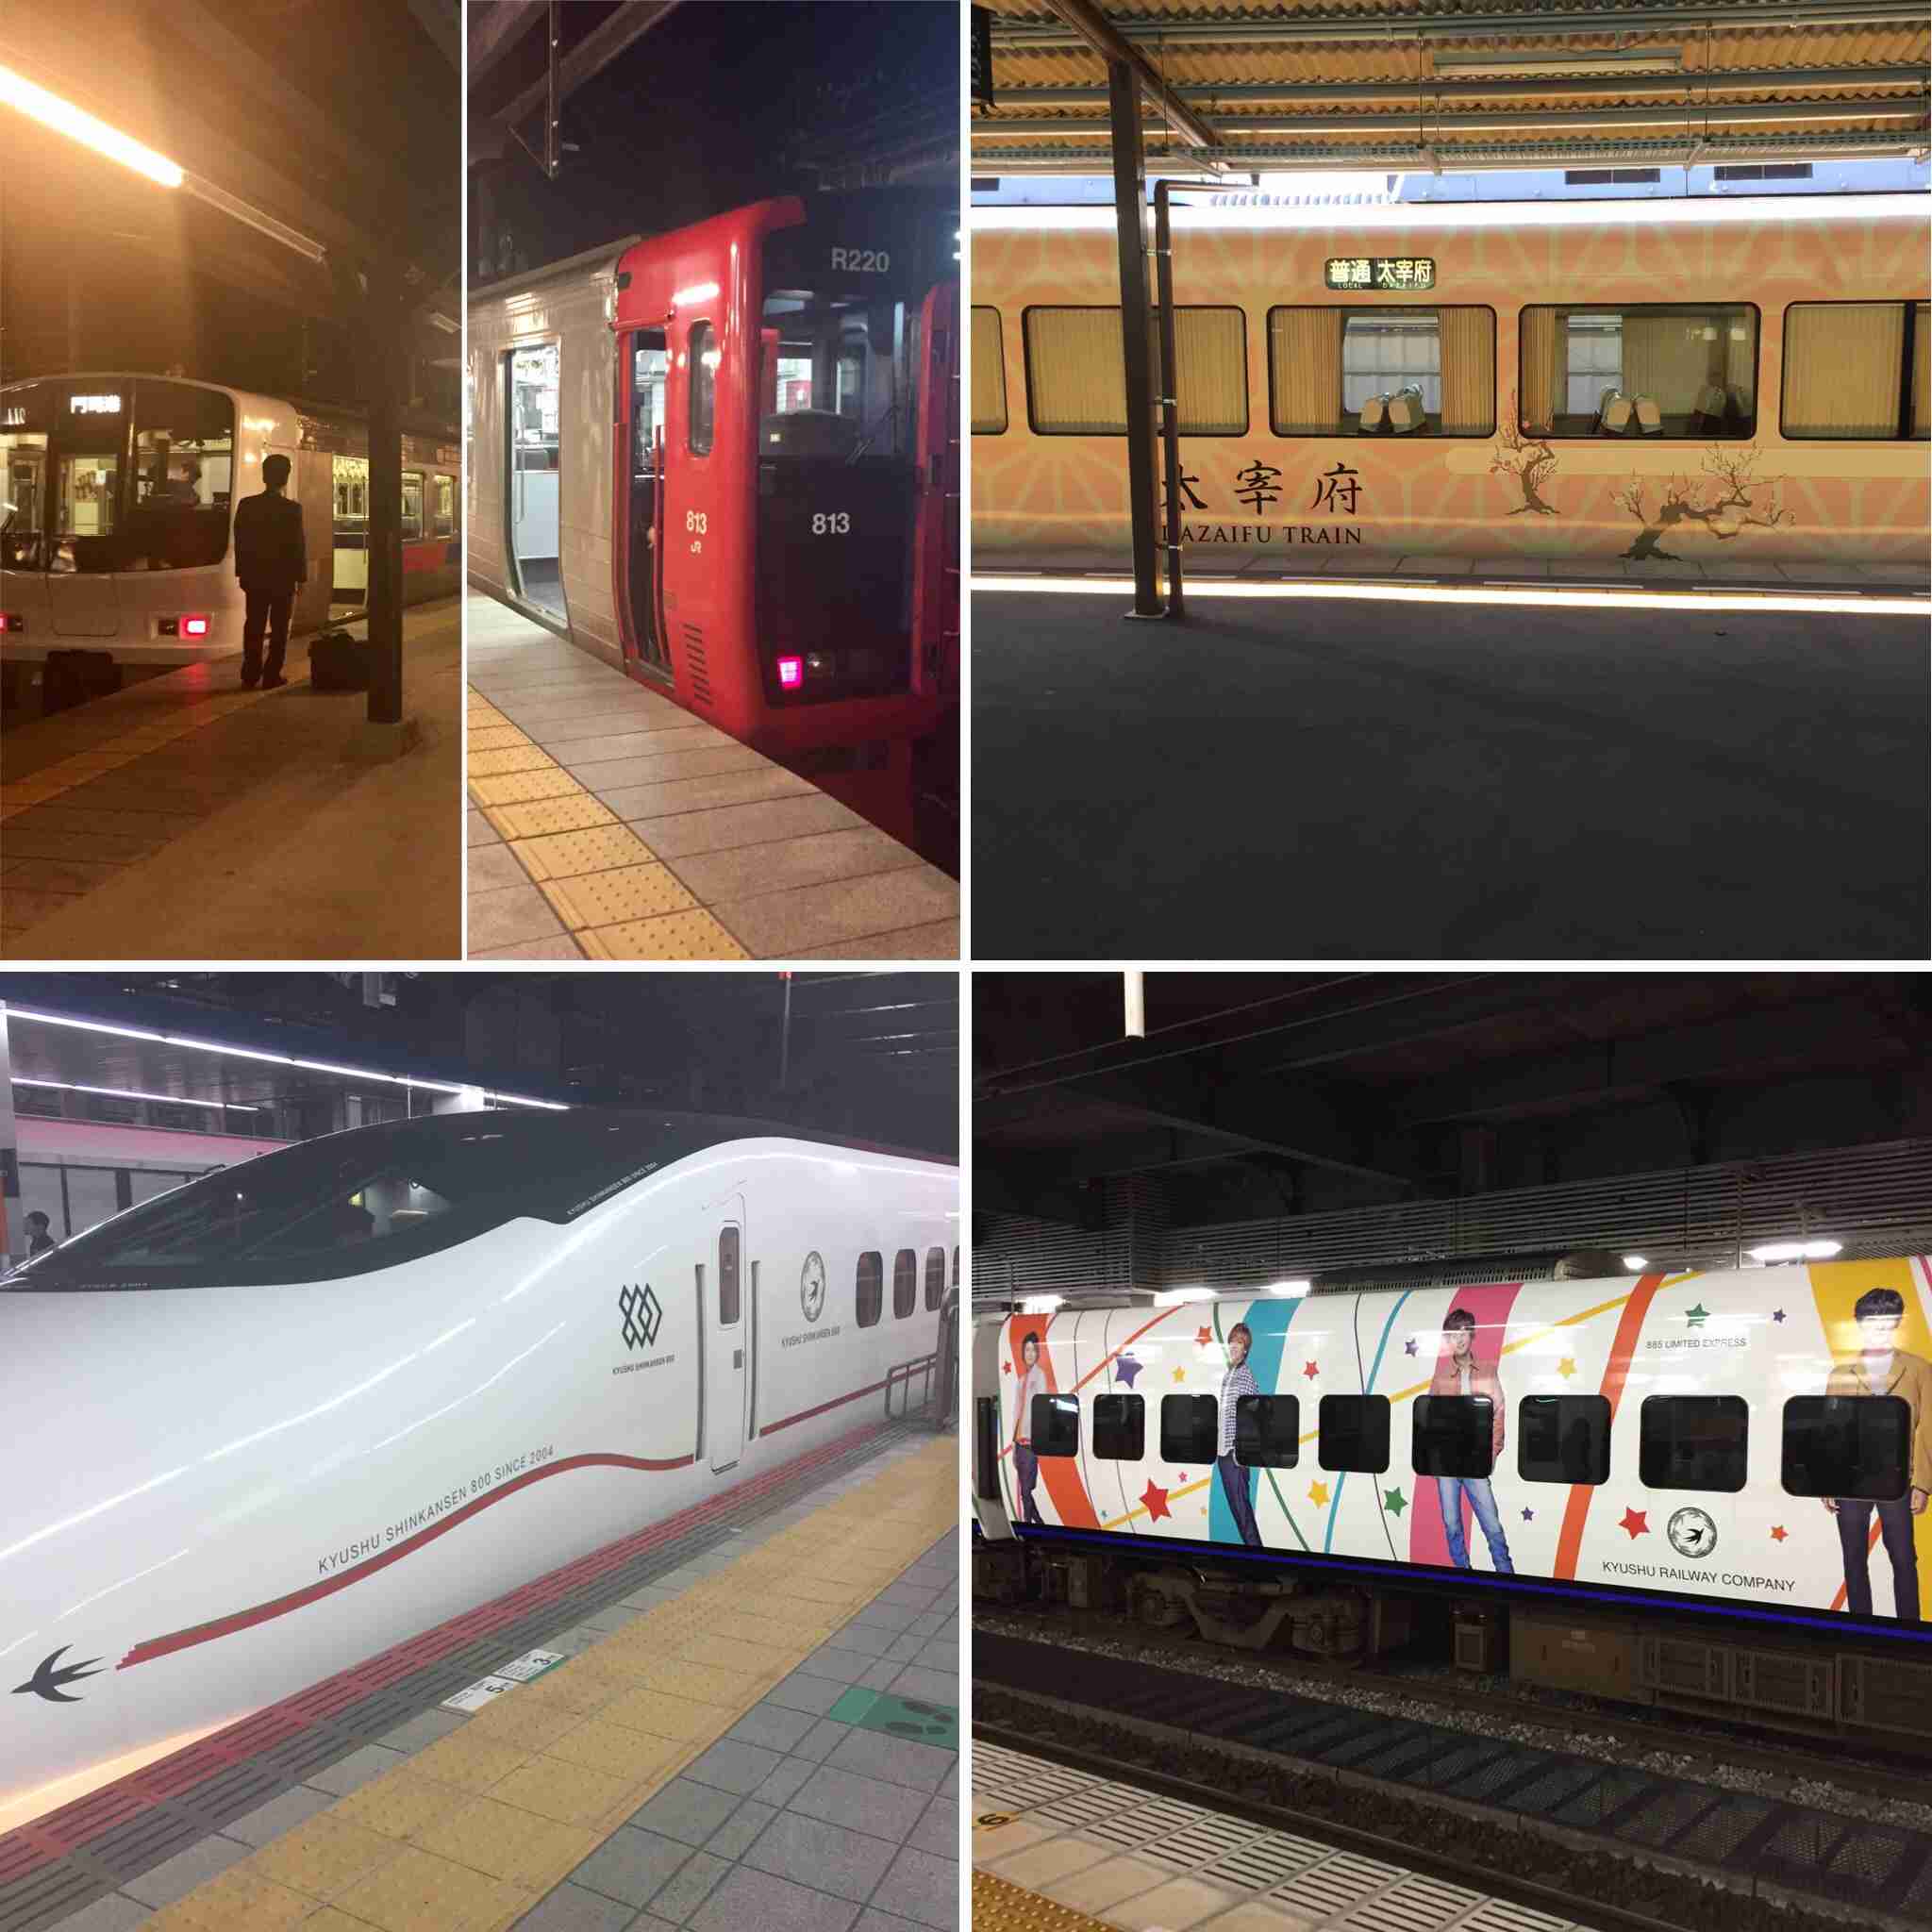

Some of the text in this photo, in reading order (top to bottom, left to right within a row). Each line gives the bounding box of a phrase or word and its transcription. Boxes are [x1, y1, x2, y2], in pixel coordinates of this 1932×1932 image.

[831, 247, 890, 273] R220
[1329, 259, 1432, 283] 普通 太宰府
[686, 510, 708, 535] 813
[812, 513, 851, 535] 813
[1283, 526, 1361, 544] TRAIN
[317, 1444, 555, 1574] KYUSHU SHINKANSEN 800 SINCE 2004
[1602, 1561, 1796, 1592] KYUSHU RAILWAY COMPANY
